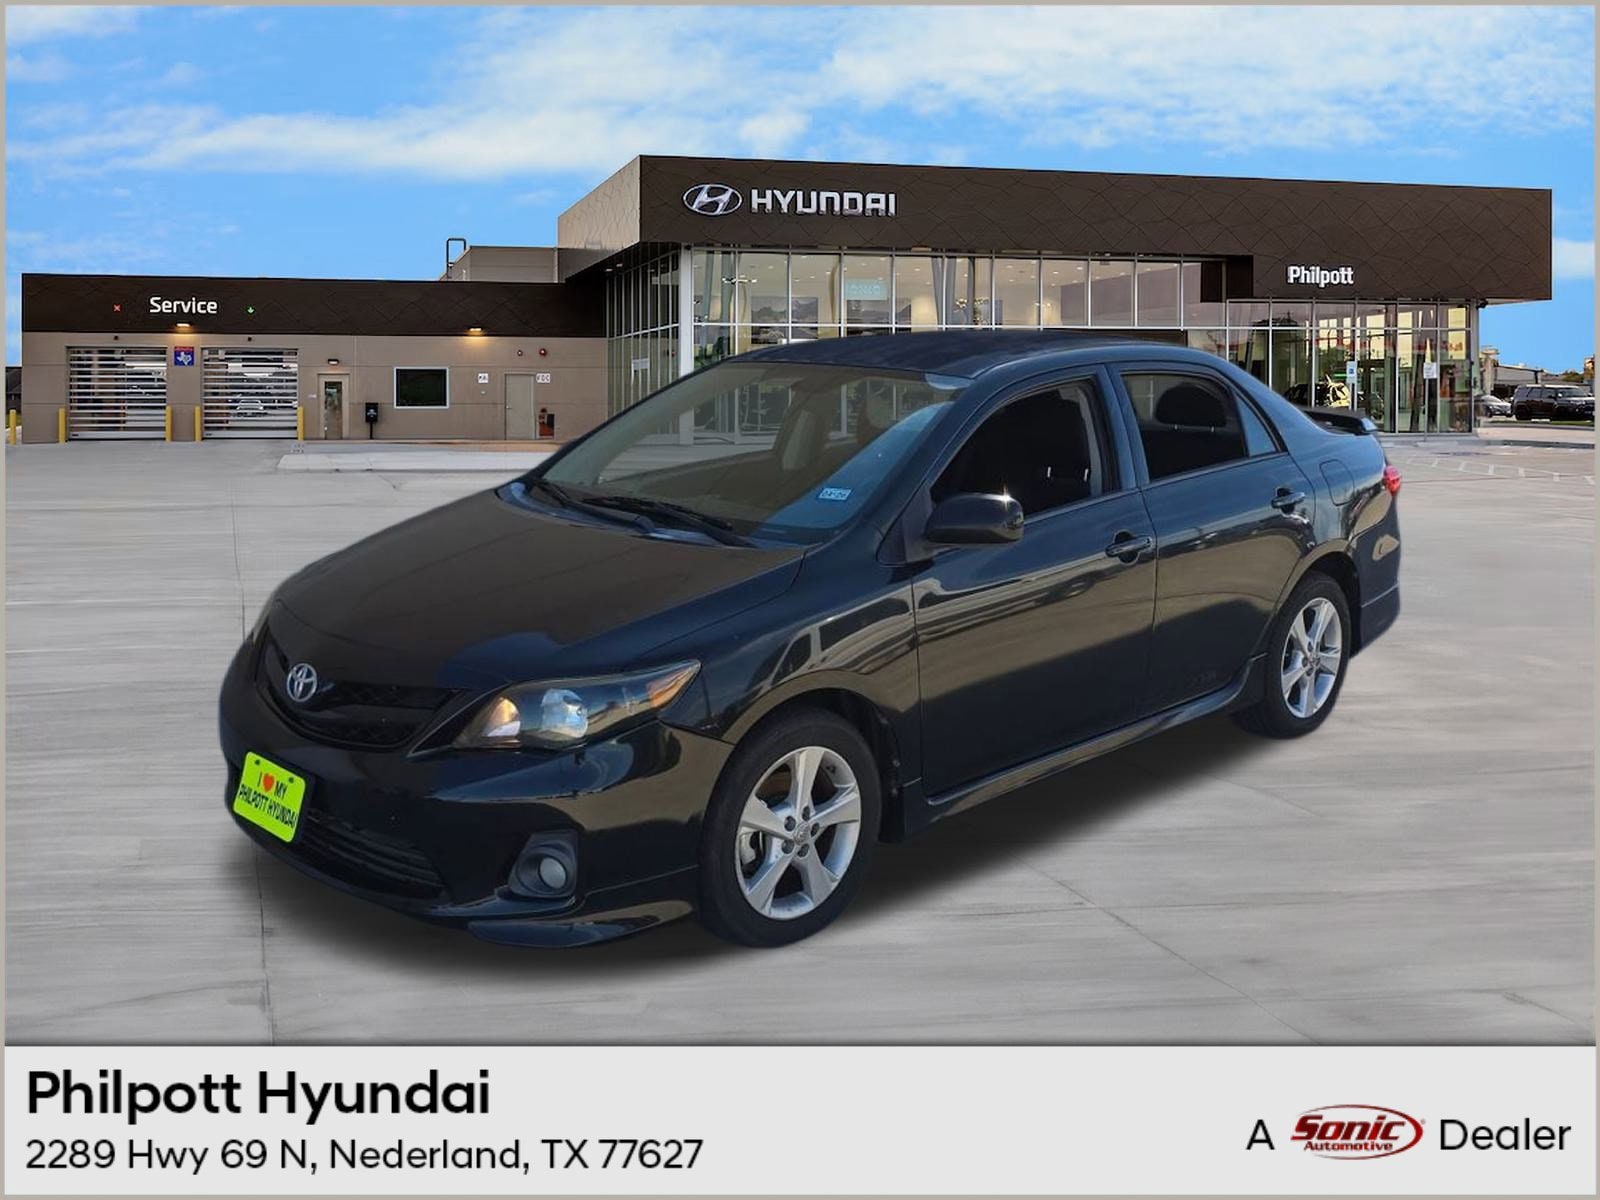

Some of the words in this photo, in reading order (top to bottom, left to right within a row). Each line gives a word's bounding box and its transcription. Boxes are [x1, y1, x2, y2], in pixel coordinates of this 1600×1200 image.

[751, 189, 897, 217] HYUNDAI
[1287, 265, 1355, 288] Philpott
[149, 296, 219, 315] Service
[239, 784, 269, 812] PHILPOTT
[274, 780, 289, 800] MY
